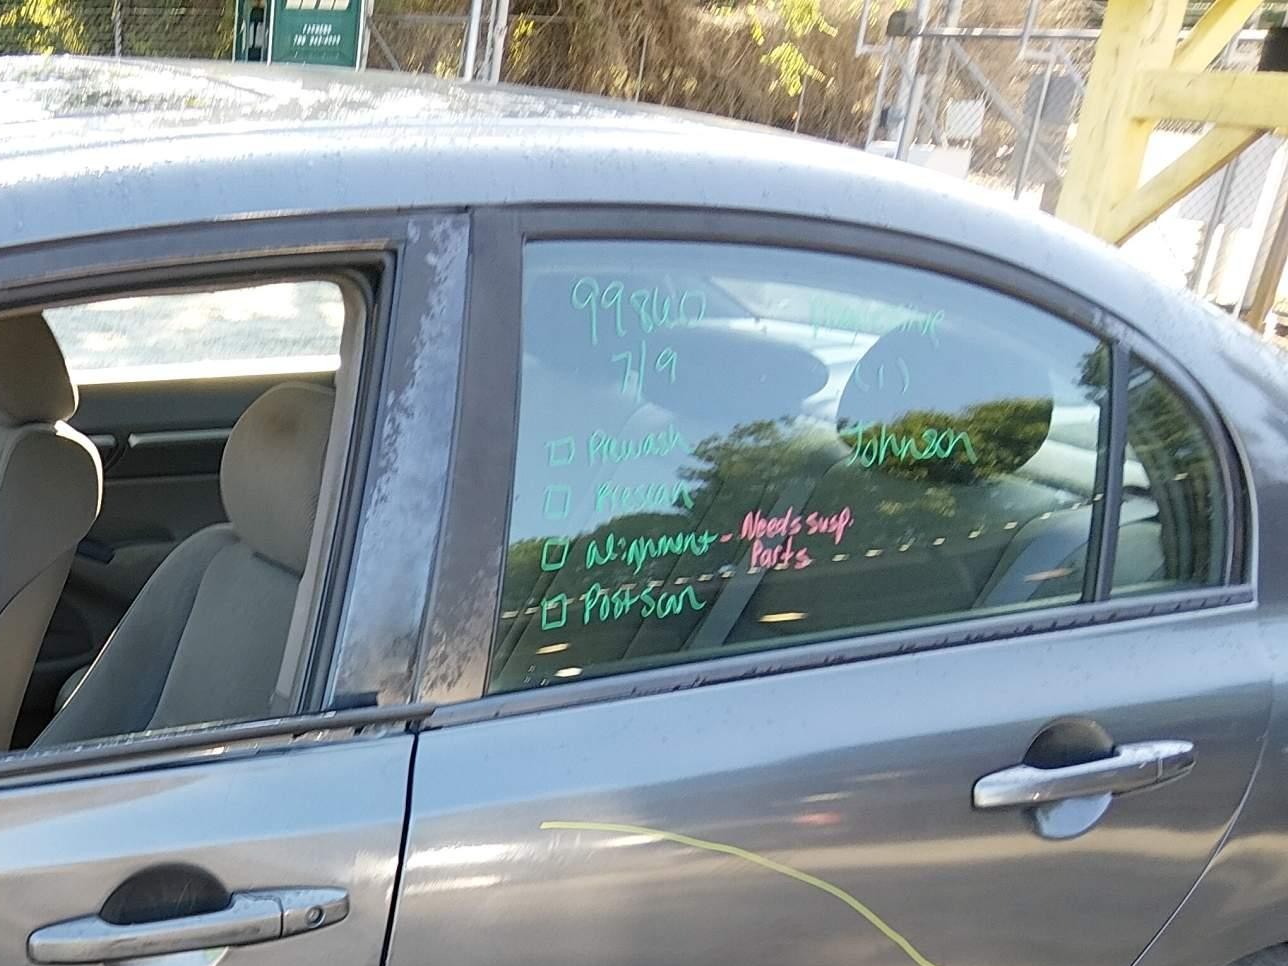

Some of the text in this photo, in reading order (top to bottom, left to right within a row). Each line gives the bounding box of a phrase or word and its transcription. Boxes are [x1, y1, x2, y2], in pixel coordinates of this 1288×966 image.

[612, 340, 678, 402] 7/9
[839, 419, 979, 468] Johnson
[740, 506, 803, 542] Needs
[750, 536, 812, 570] Parts
